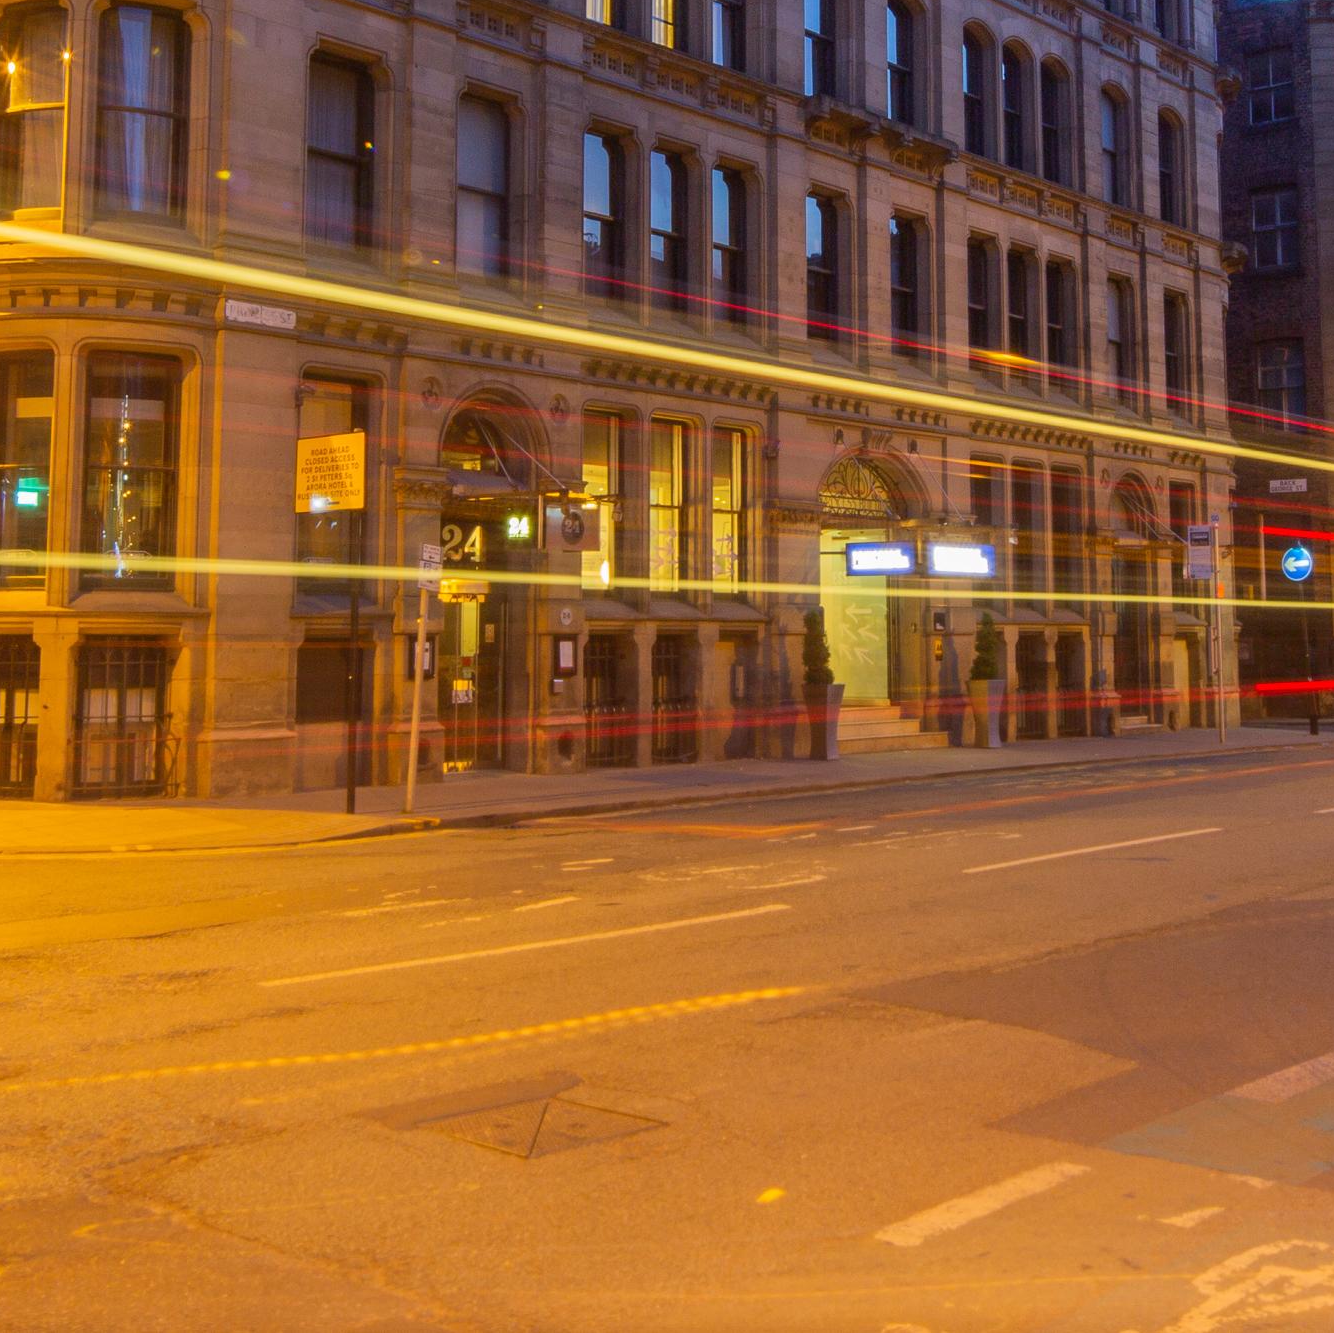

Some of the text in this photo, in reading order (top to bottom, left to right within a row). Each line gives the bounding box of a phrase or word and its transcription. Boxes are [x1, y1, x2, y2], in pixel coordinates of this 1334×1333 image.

[311, 446, 349, 456] ROAD AHEAD
[305, 454, 354, 466] CLOSED ACCESS
[315, 464, 349, 473] DELIVERIES
[320, 473, 342, 481] PETERS
[329, 481, 347, 489] HOTEL
[509, 517, 528, 534] 24
[565, 519, 580, 533] 24
[442, 524, 483, 562] 24
